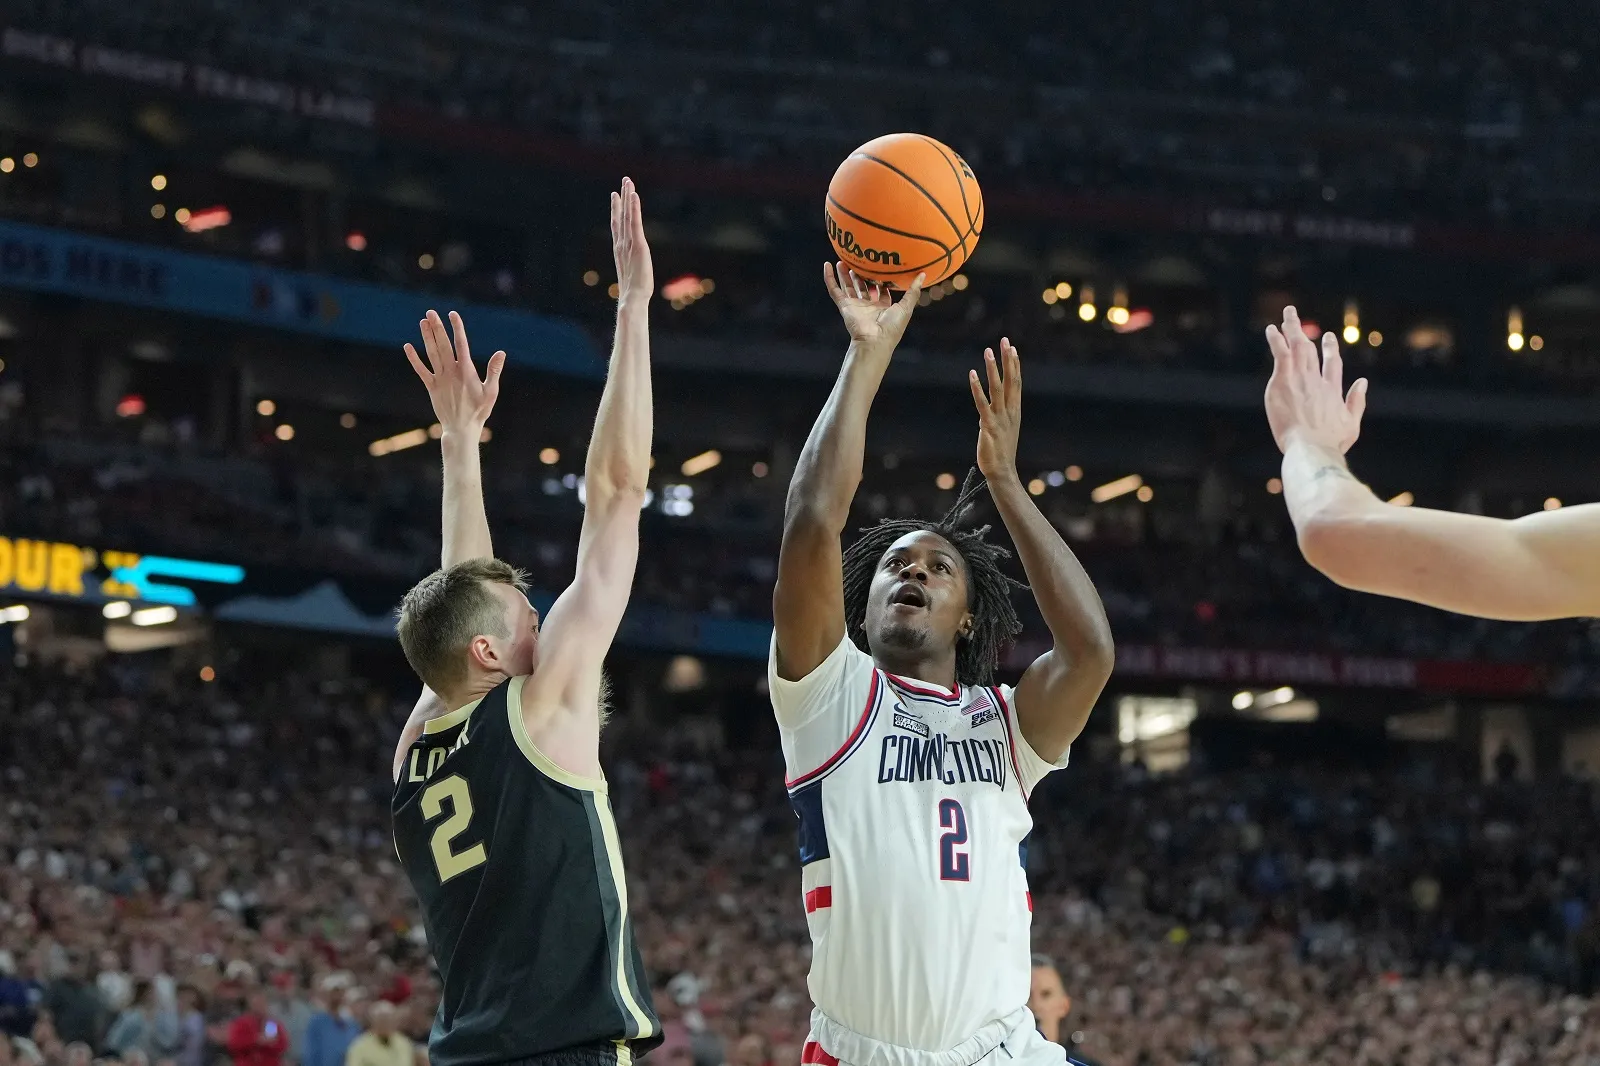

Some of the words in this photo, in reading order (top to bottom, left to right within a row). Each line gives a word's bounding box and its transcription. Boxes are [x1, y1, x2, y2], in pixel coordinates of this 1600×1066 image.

[971, 709, 991, 721] BIG
[878, 733, 1006, 791] CONNCTICUT
[418, 772, 488, 886] 2
[938, 798, 970, 881] 2
